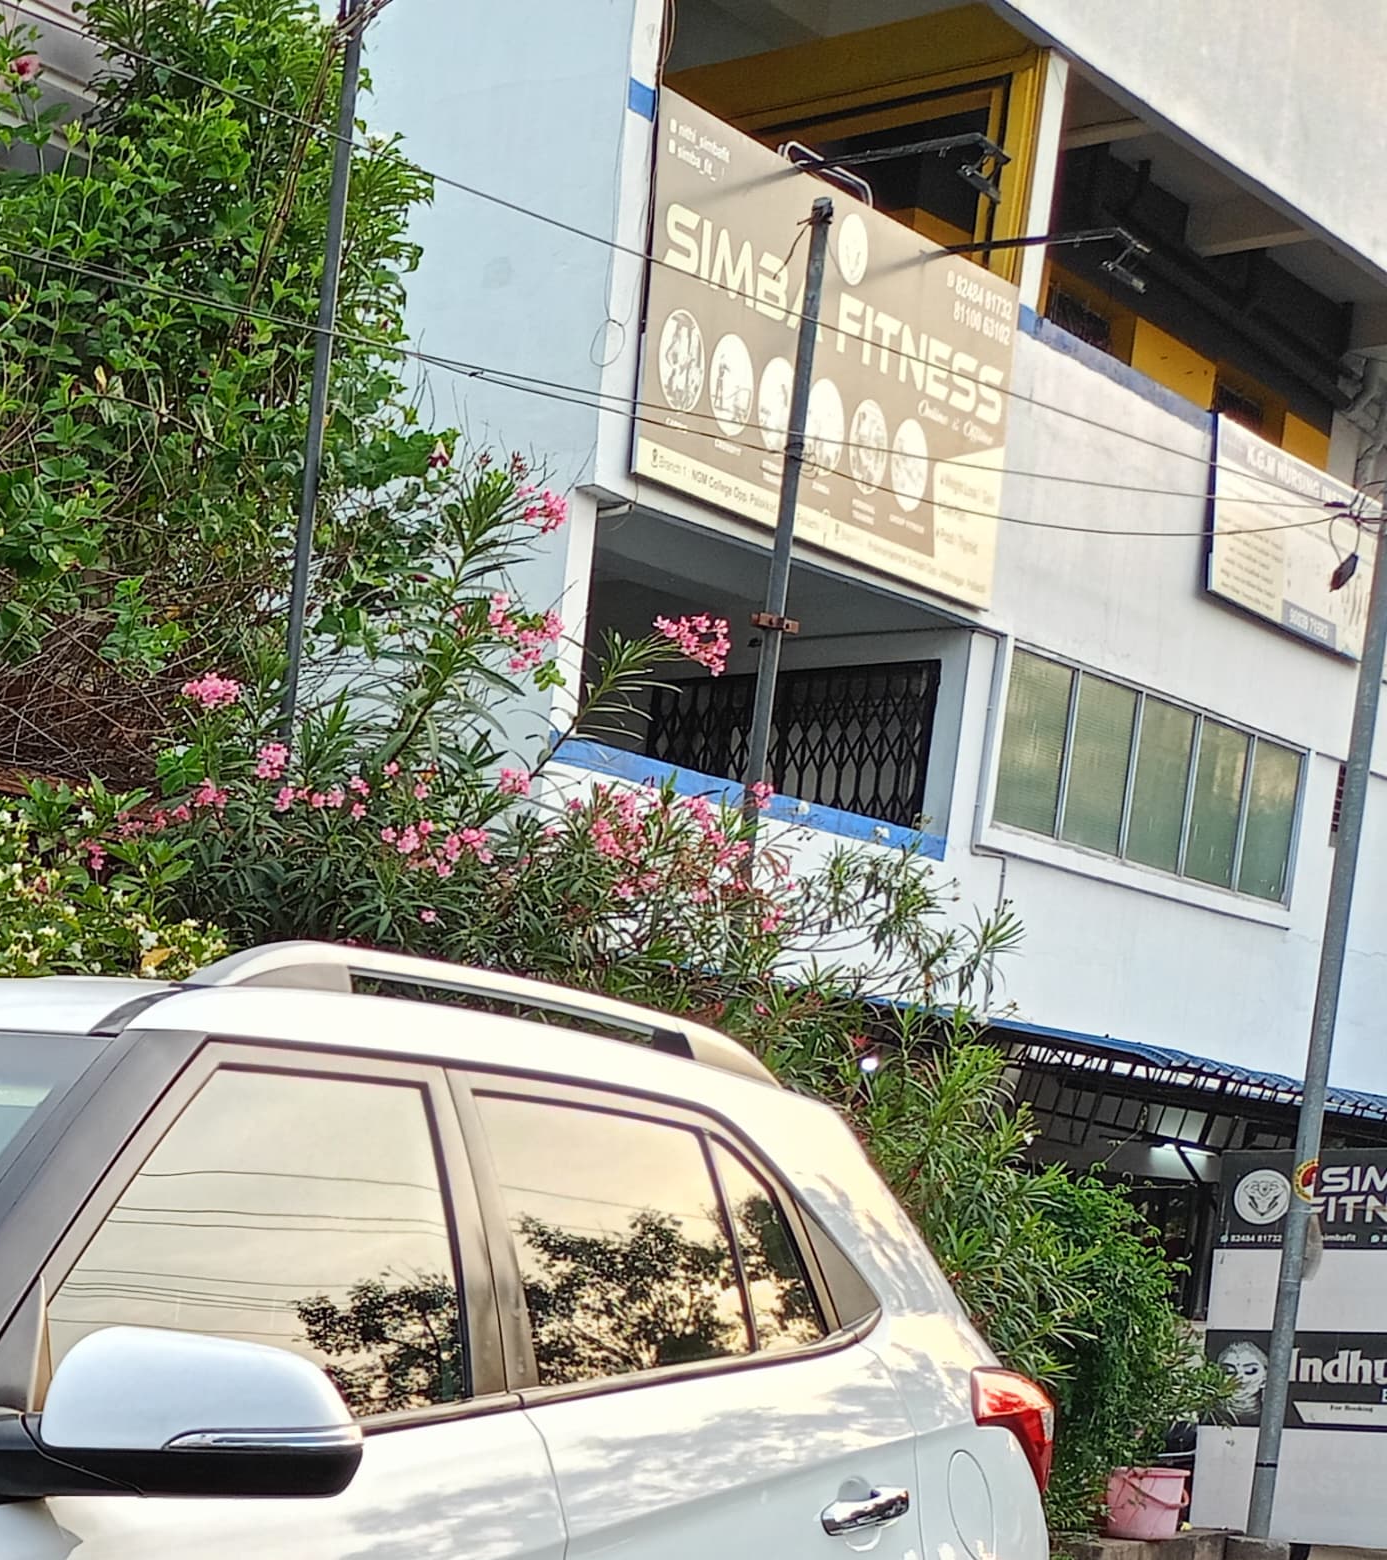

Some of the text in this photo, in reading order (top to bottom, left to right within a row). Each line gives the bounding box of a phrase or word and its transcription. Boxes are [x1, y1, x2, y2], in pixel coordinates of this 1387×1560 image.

[664, 202, 1005, 425] SIMBA FITNESS
[953, 300, 982, 331] 81100
[955, 274, 1013, 321] 82484 81732
[1277, 457, 1321, 499] NURSING
[1230, 1234, 1282, 1243] 82484 81732
